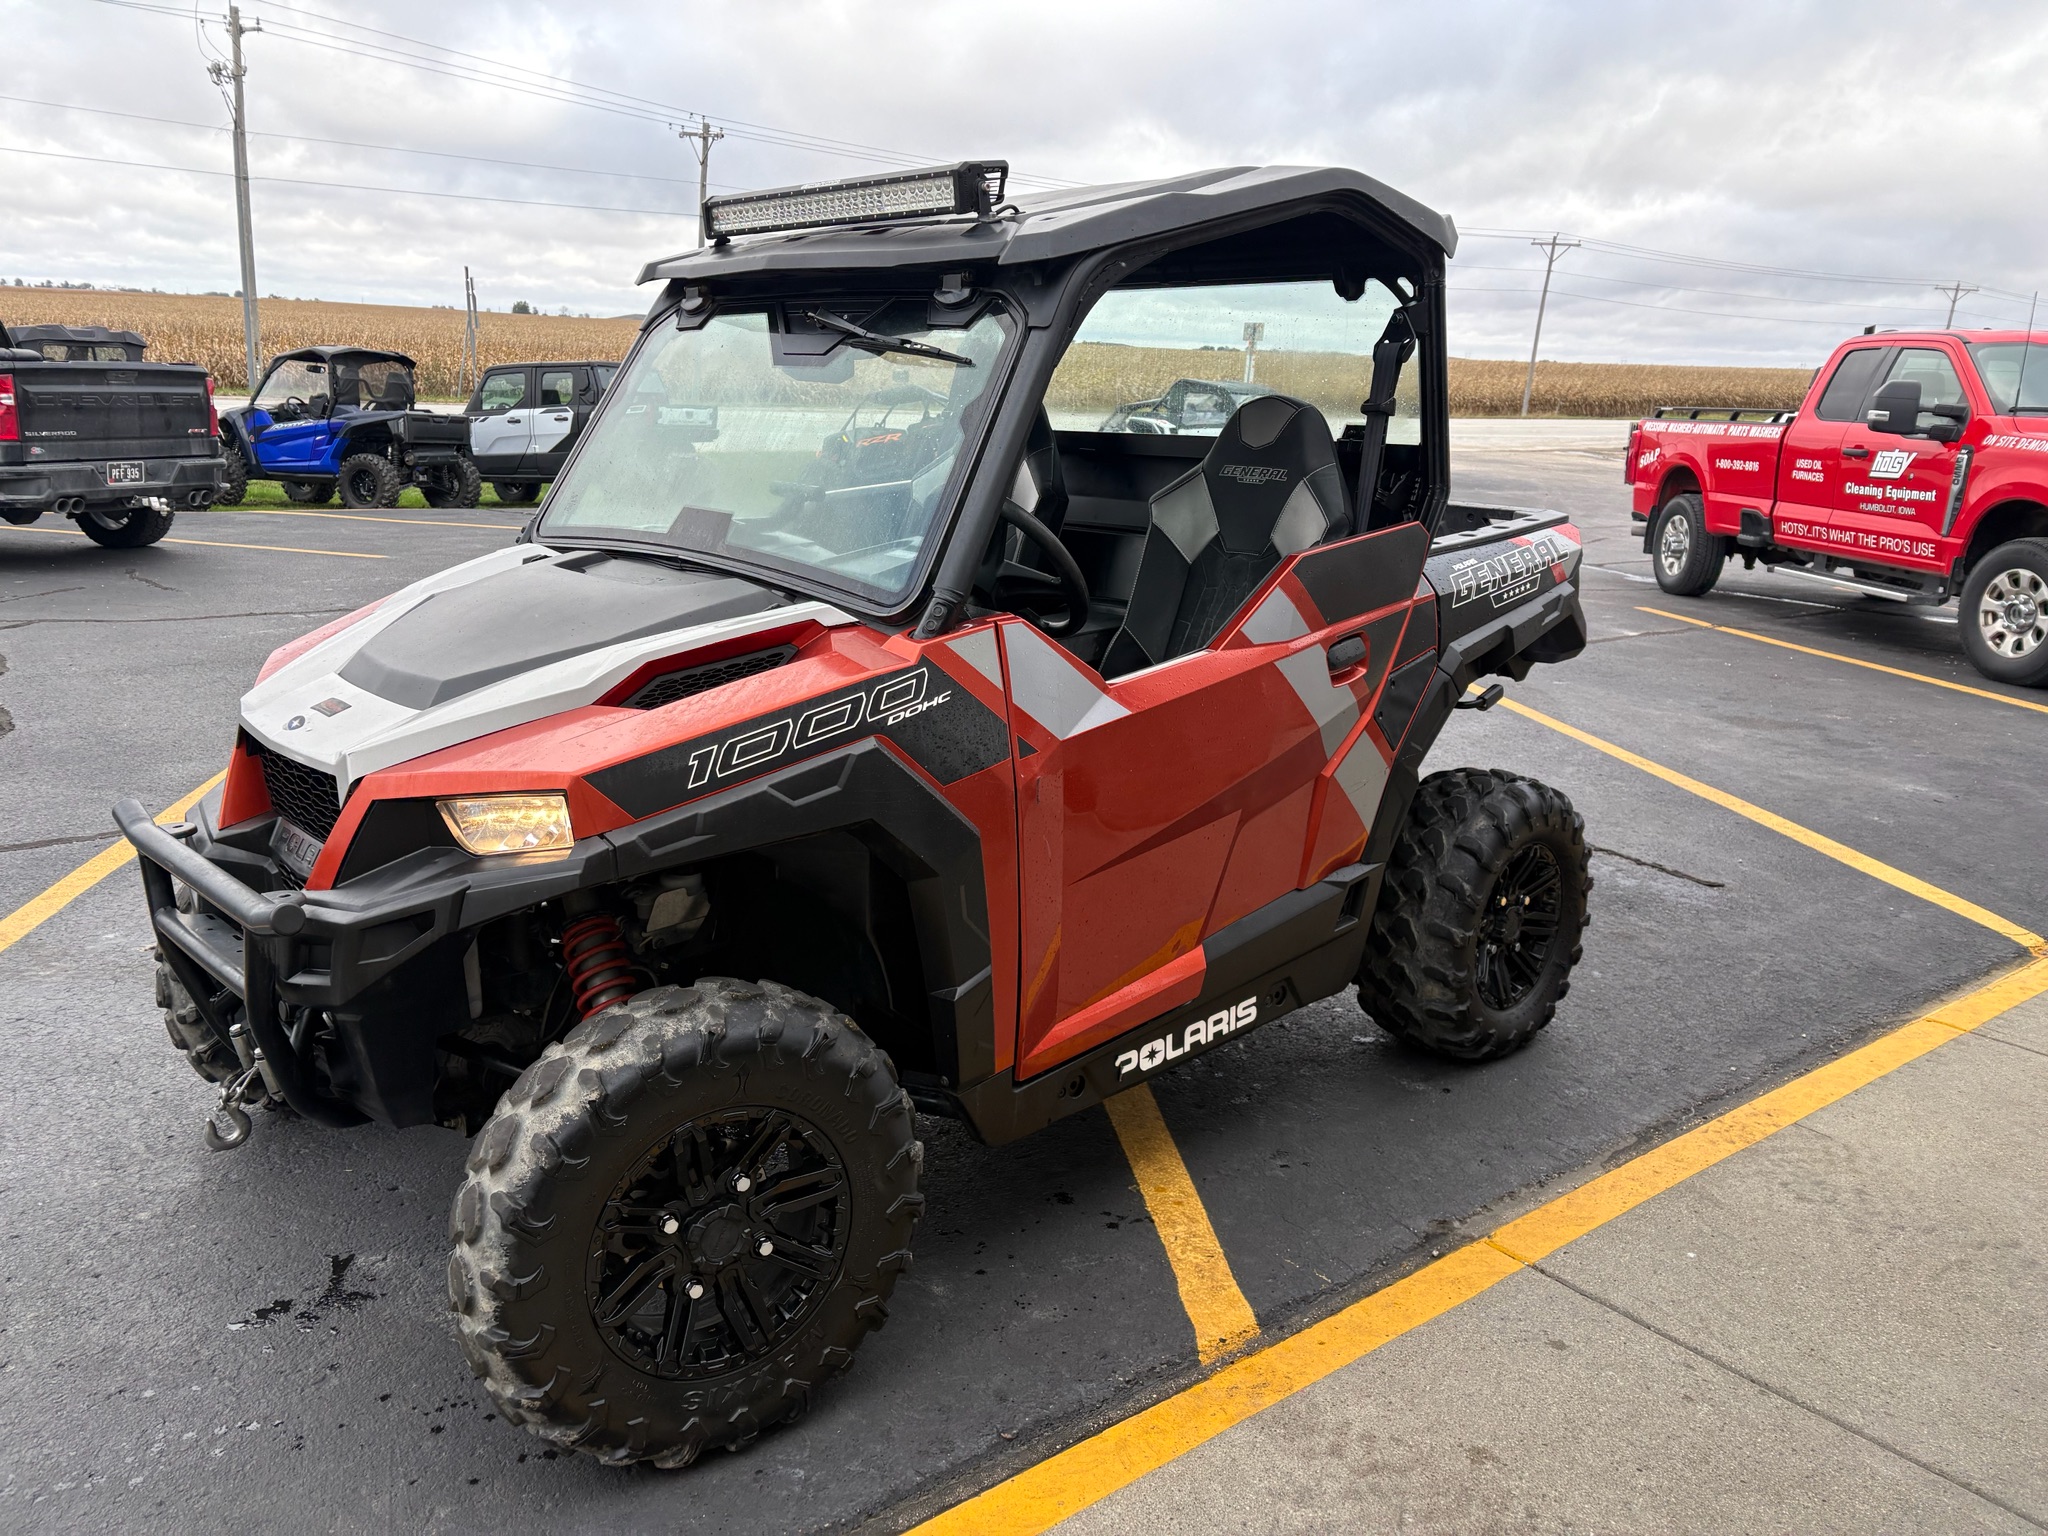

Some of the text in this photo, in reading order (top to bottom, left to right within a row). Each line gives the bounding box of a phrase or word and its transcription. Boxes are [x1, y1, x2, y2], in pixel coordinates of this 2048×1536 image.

[1727, 425, 1750, 437] PARTS
[1749, 426, 1783, 439] WASHERS
[1983, 434, 2000, 446] ON
[1995, 435, 2020, 449] SITE
[1639, 447, 1661, 469] SOAP
[1796, 459, 1823, 470] USED OIL
[1219, 465, 1288, 481] GENERAL
[1792, 470, 1824, 483] FURNACES
[1845, 482, 1937, 502] Cleaning Equipment
[1898, 505, 1916, 516] IOWA
[1828, 528, 1856, 544] WHAT
[1858, 533, 1877, 548] THE
[1880, 536, 1911, 553] PRO'S
[1913, 542, 1936, 557] USE
[1450, 536, 1570, 609] GENERAL
[887, 690, 952, 726] DOHC
[687, 667, 929, 790] 1000
[1115, 996, 1258, 1081] POLARIS
